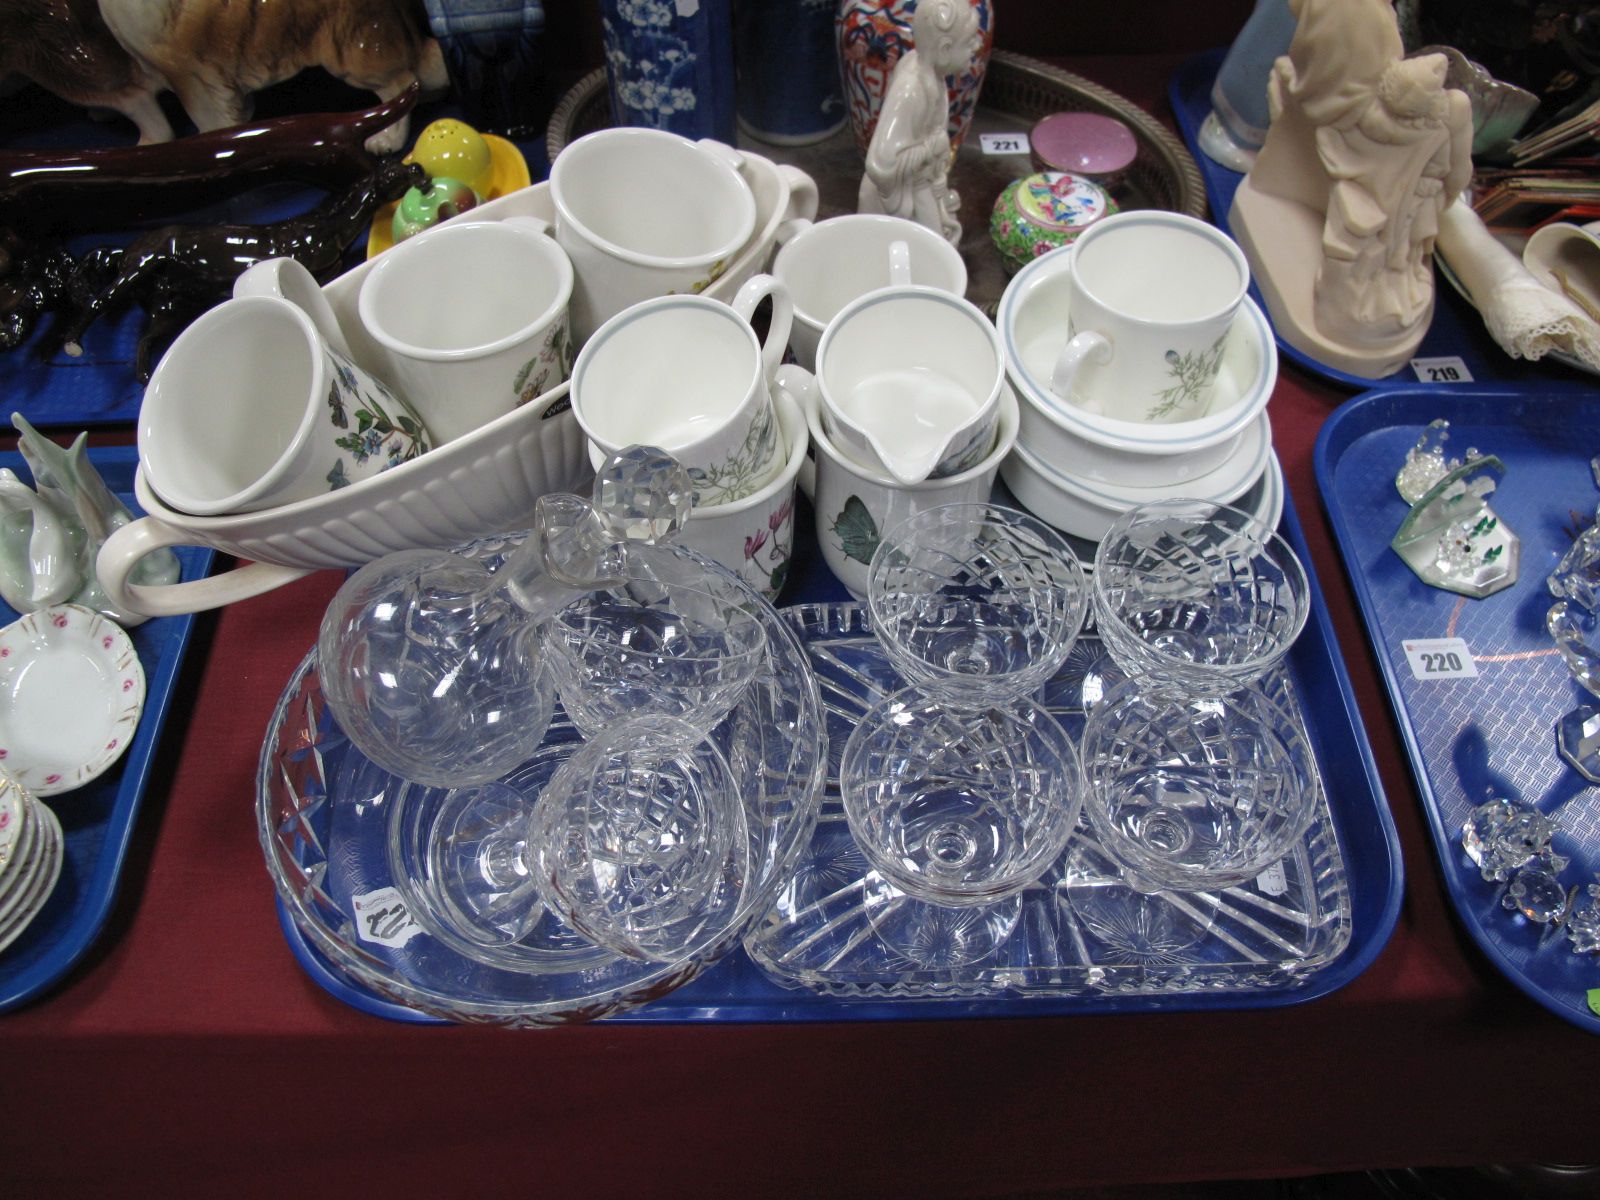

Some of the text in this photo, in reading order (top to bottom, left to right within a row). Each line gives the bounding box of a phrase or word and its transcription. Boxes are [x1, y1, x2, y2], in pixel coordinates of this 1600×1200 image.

[992, 140, 1019, 150] 221
[1427, 366, 1460, 381] 219
[1420, 652, 1463, 673] 220
